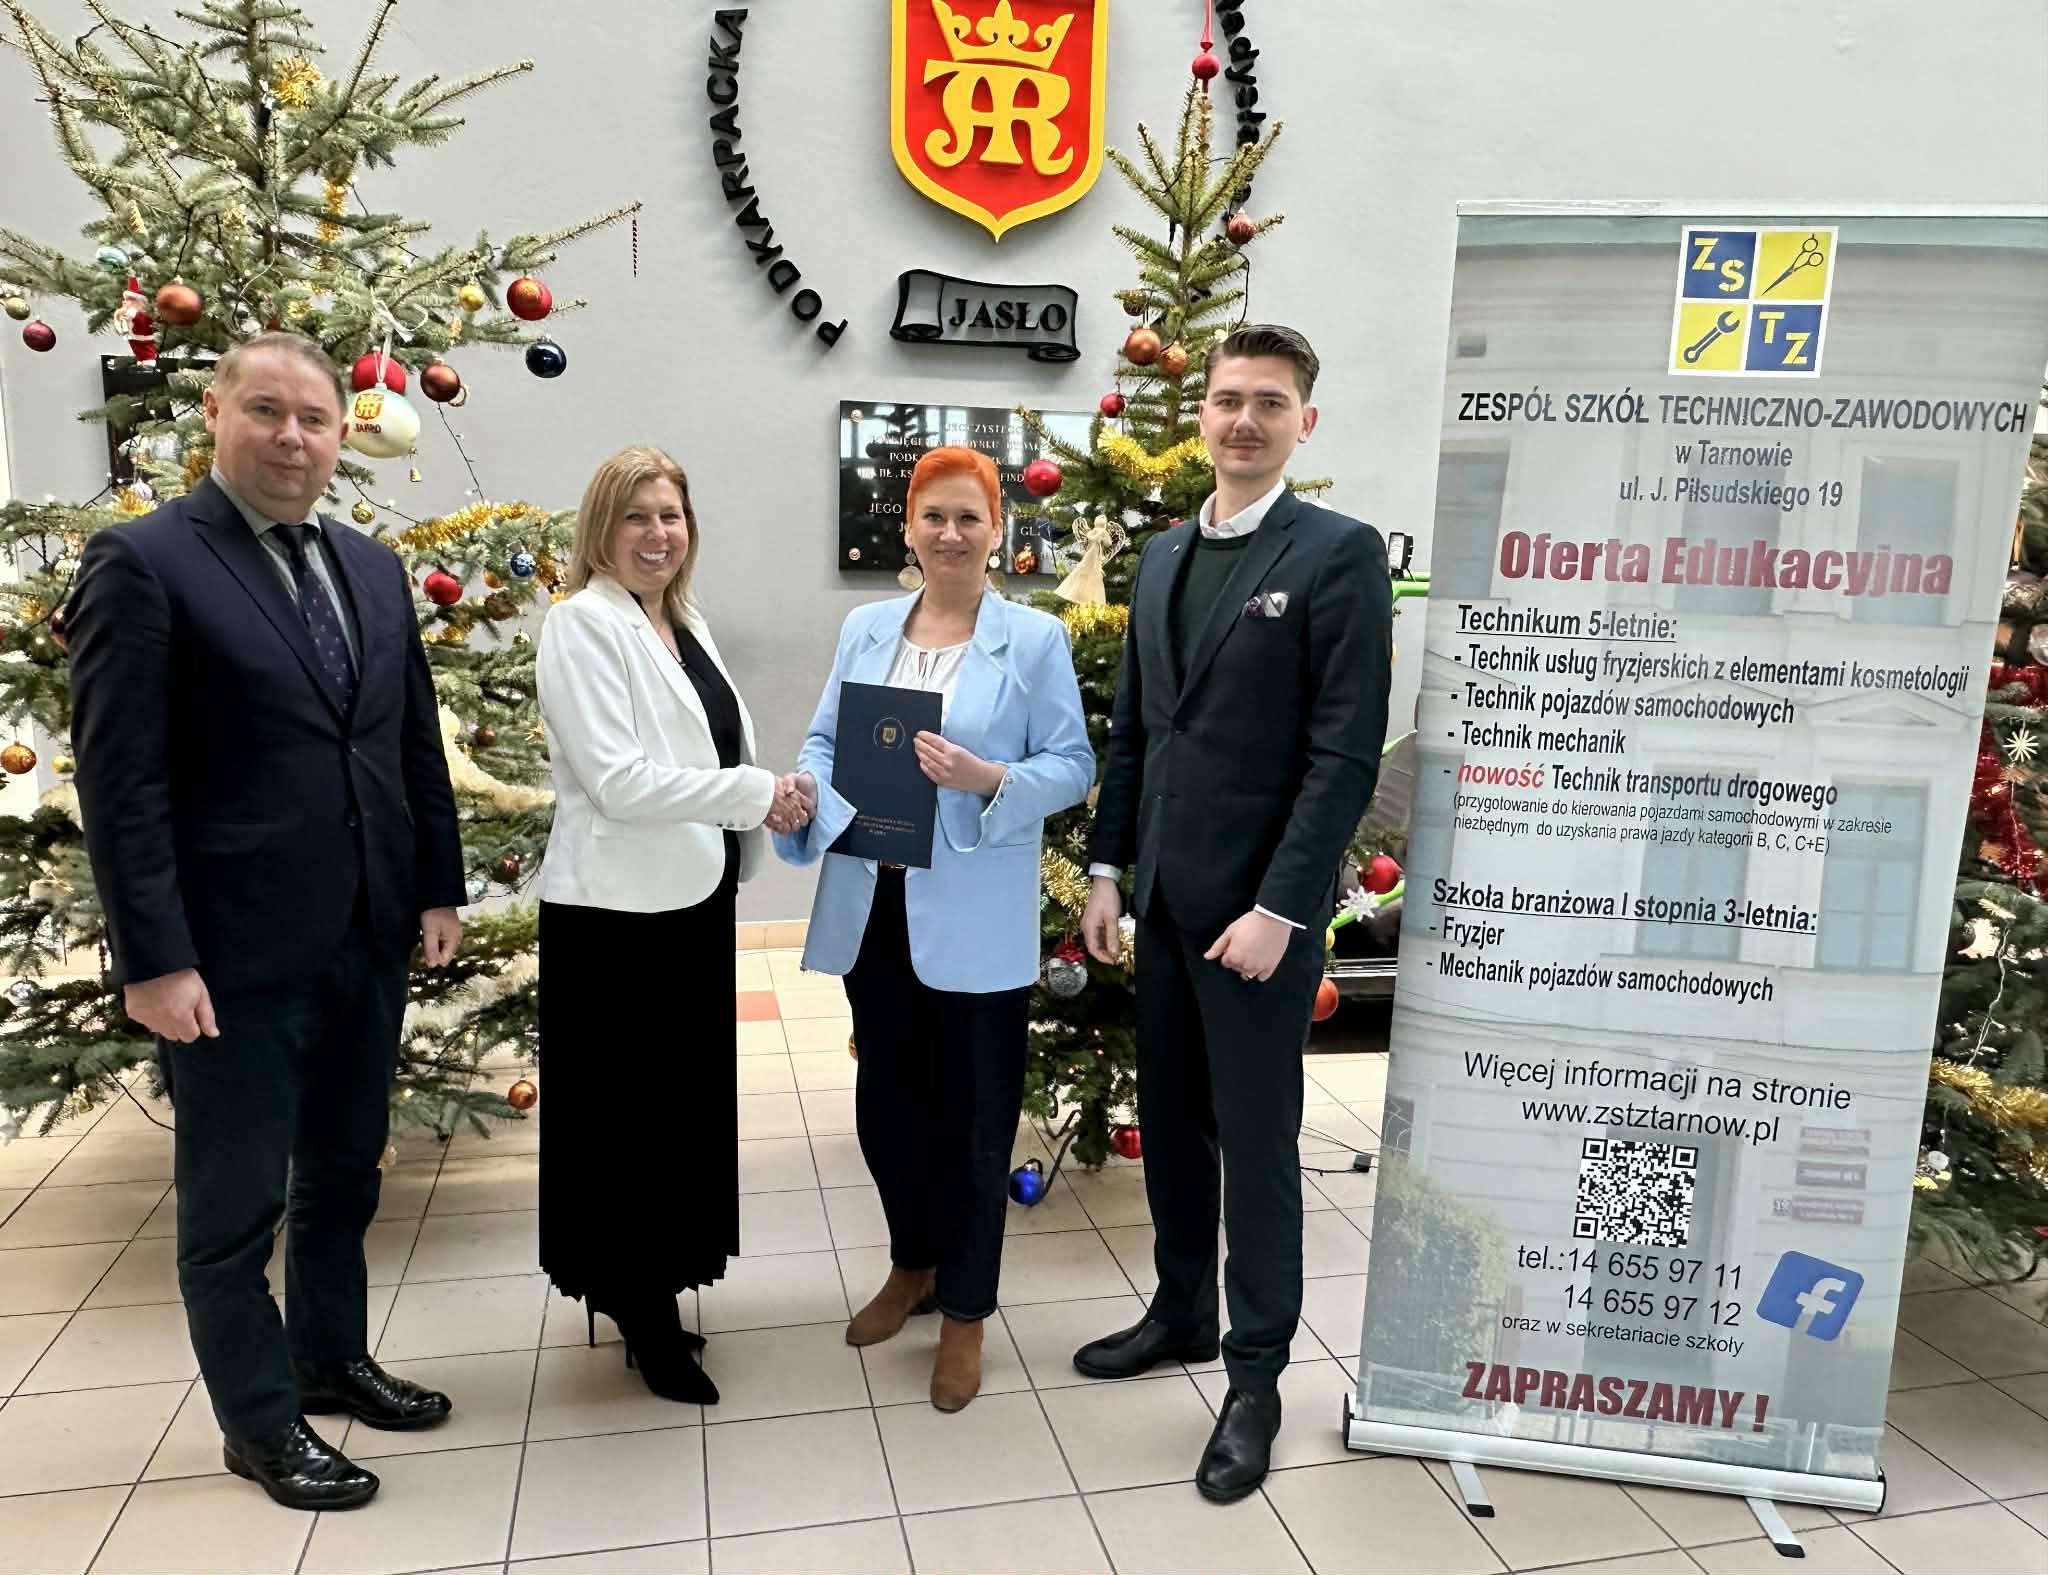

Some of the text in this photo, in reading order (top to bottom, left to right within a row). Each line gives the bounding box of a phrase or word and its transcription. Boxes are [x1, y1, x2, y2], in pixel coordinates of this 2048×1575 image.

[707, 9, 848, 348] PODKARPACKA
[950, 298, 1067, 331] JASŁO
[1459, 386, 2029, 433] ZESPÓŁ SZKÓŁ TECHNICZNO-ZAWODOWYCH
[1676, 440, 1792, 467] w Tarnowie
[869, 502, 902, 514] JEGO
[1620, 476, 1842, 511] ul. J. Piłsudskiego 19
[1500, 531, 1953, 596] Oferta Edukacyjna
[1458, 604, 1677, 641] Technikum 5-letnie:
[1468, 643, 1539, 672] Technik
[1546, 648, 1597, 681] usług
[1603, 651, 1708, 682] fryzjerskich
[1713, 661, 1724, 679] z
[1731, 657, 1844, 685] elementami
[1851, 661, 1969, 698] kosmetologii
[1465, 681, 1535, 711] Technik
[1541, 688, 1630, 719] pojazdów
[1634, 692, 1794, 727] samochodowych
[1462, 720, 1532, 749] Technik
[1538, 728, 1626, 753] mechanik
[1458, 762, 1544, 789] nowość
[1552, 765, 1621, 792] Technik
[1626, 769, 1721, 799] transportu
[1728, 774, 1838, 810] drogowego
[1454, 792, 1892, 833] (przygotowanie do kierowania pojazdami samochodowymi w zakresie
[1454, 816, 1528, 837] niezbędnym
[1537, 821, 1552, 835] do
[1557, 822, 1616, 840] uzyskania
[1620, 828, 1657, 842] prawa
[1660, 826, 1695, 846] jazdy
[1699, 829, 1752, 848] kategorii
[1433, 878, 1504, 909] Szkoła
[1511, 887, 1615, 916] branżowa
[1634, 896, 1716, 925] stopnia
[1724, 900, 1817, 931] 3-letnia:
[1444, 916, 1504, 950] Fryzjer
[1440, 952, 1524, 983] Mechanik
[1529, 962, 1613, 991] pojazdów
[1617, 969, 1774, 1003] samochodowych
[1465, 1052, 1850, 1109] Więcej informacji na stronie
[1522, 1101, 1779, 1145] www.zstztarnow.pl
[1609, 1252, 1659, 1280] 655
[1669, 1258, 1703, 1284] 97
[1715, 1264, 1742, 1290] 11
[1565, 1284, 1741, 1326] 14 655 97 12
[1502, 1317, 1744, 1357] oraz w sekretariacie szkoły
[1462, 1361, 1744, 1429] ZAPRASZAMY
